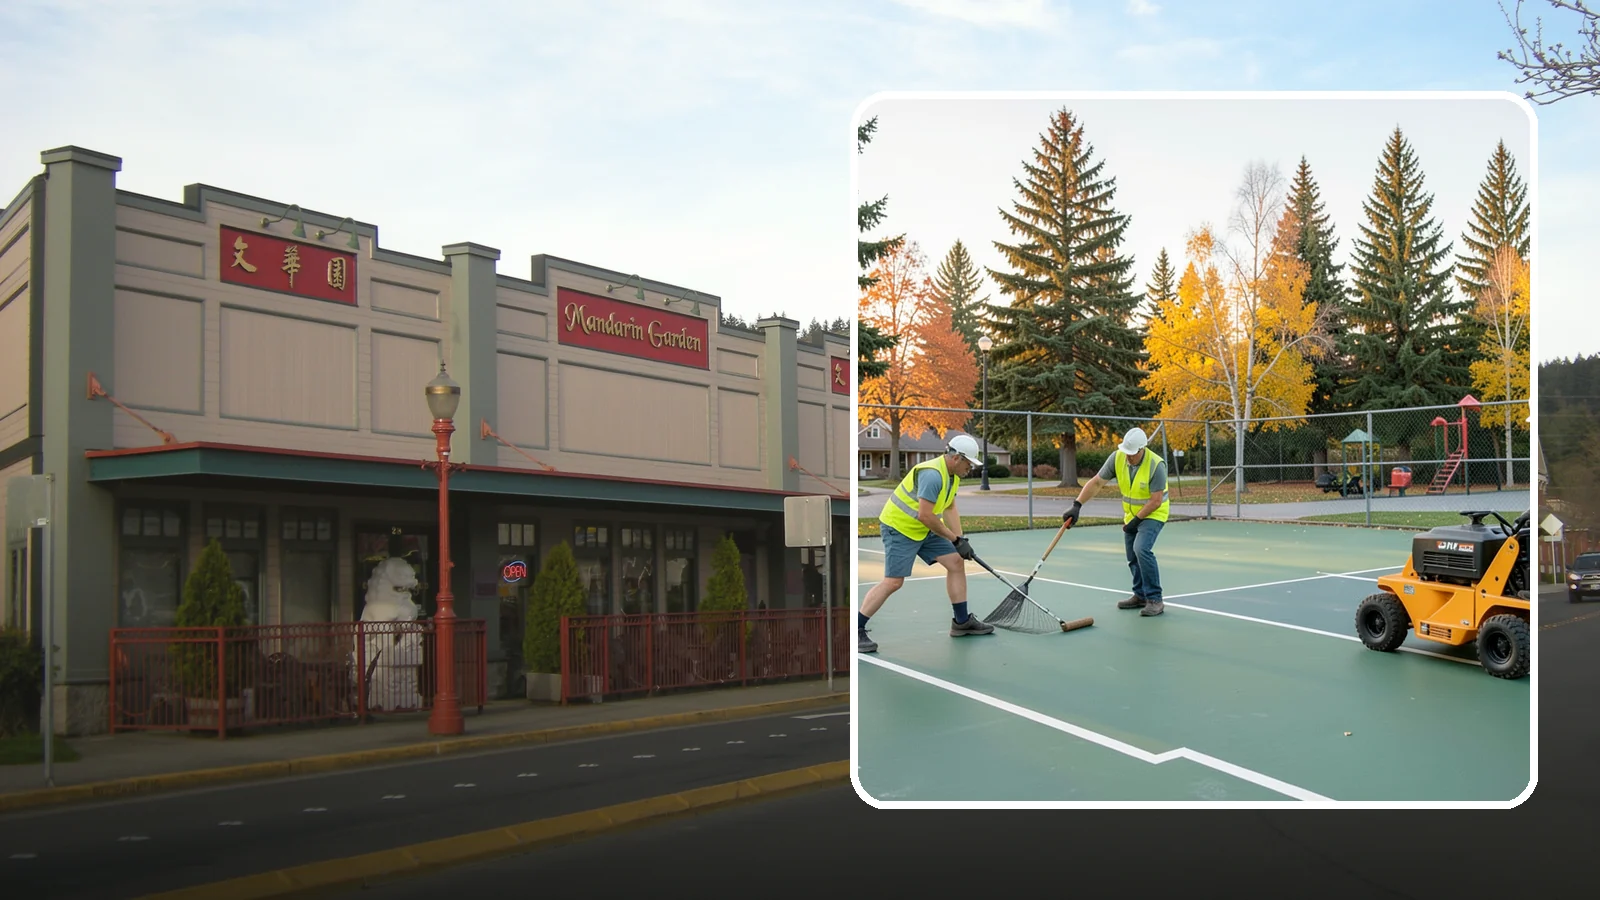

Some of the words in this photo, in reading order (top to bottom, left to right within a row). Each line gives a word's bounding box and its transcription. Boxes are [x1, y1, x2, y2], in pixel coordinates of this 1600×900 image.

[231, 235, 346, 291] 文華園
[564, 302, 644, 341] Mandarin
[648, 320, 701, 352] Garden
[835, 363, 847, 386] 文
[503, 565, 527, 578] OPEN
